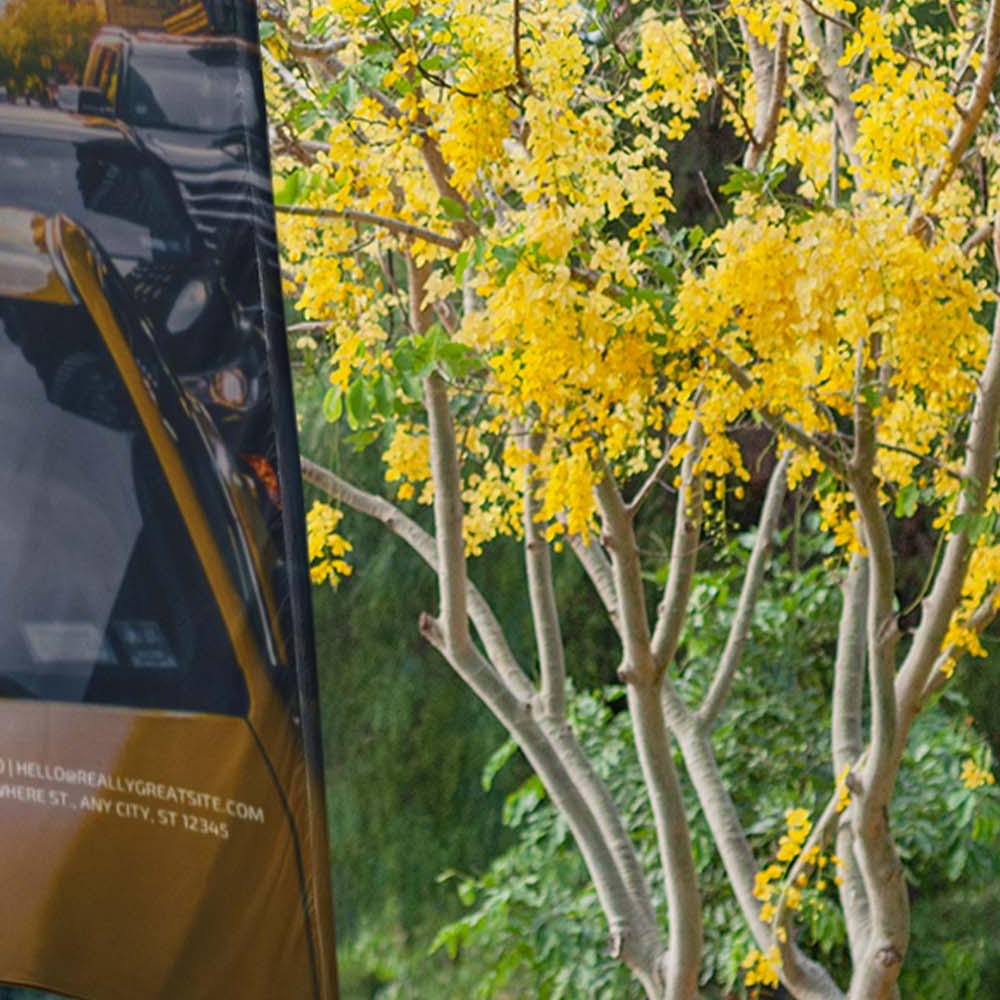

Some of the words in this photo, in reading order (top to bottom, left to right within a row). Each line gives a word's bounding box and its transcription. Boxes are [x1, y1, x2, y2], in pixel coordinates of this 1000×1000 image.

[16, 761, 265, 823] HELLO@REALLYGREATSITE.COM
[79, 795, 113, 814] ANY
[157, 808, 178, 828] ST
[182, 813, 230, 840] 12345
